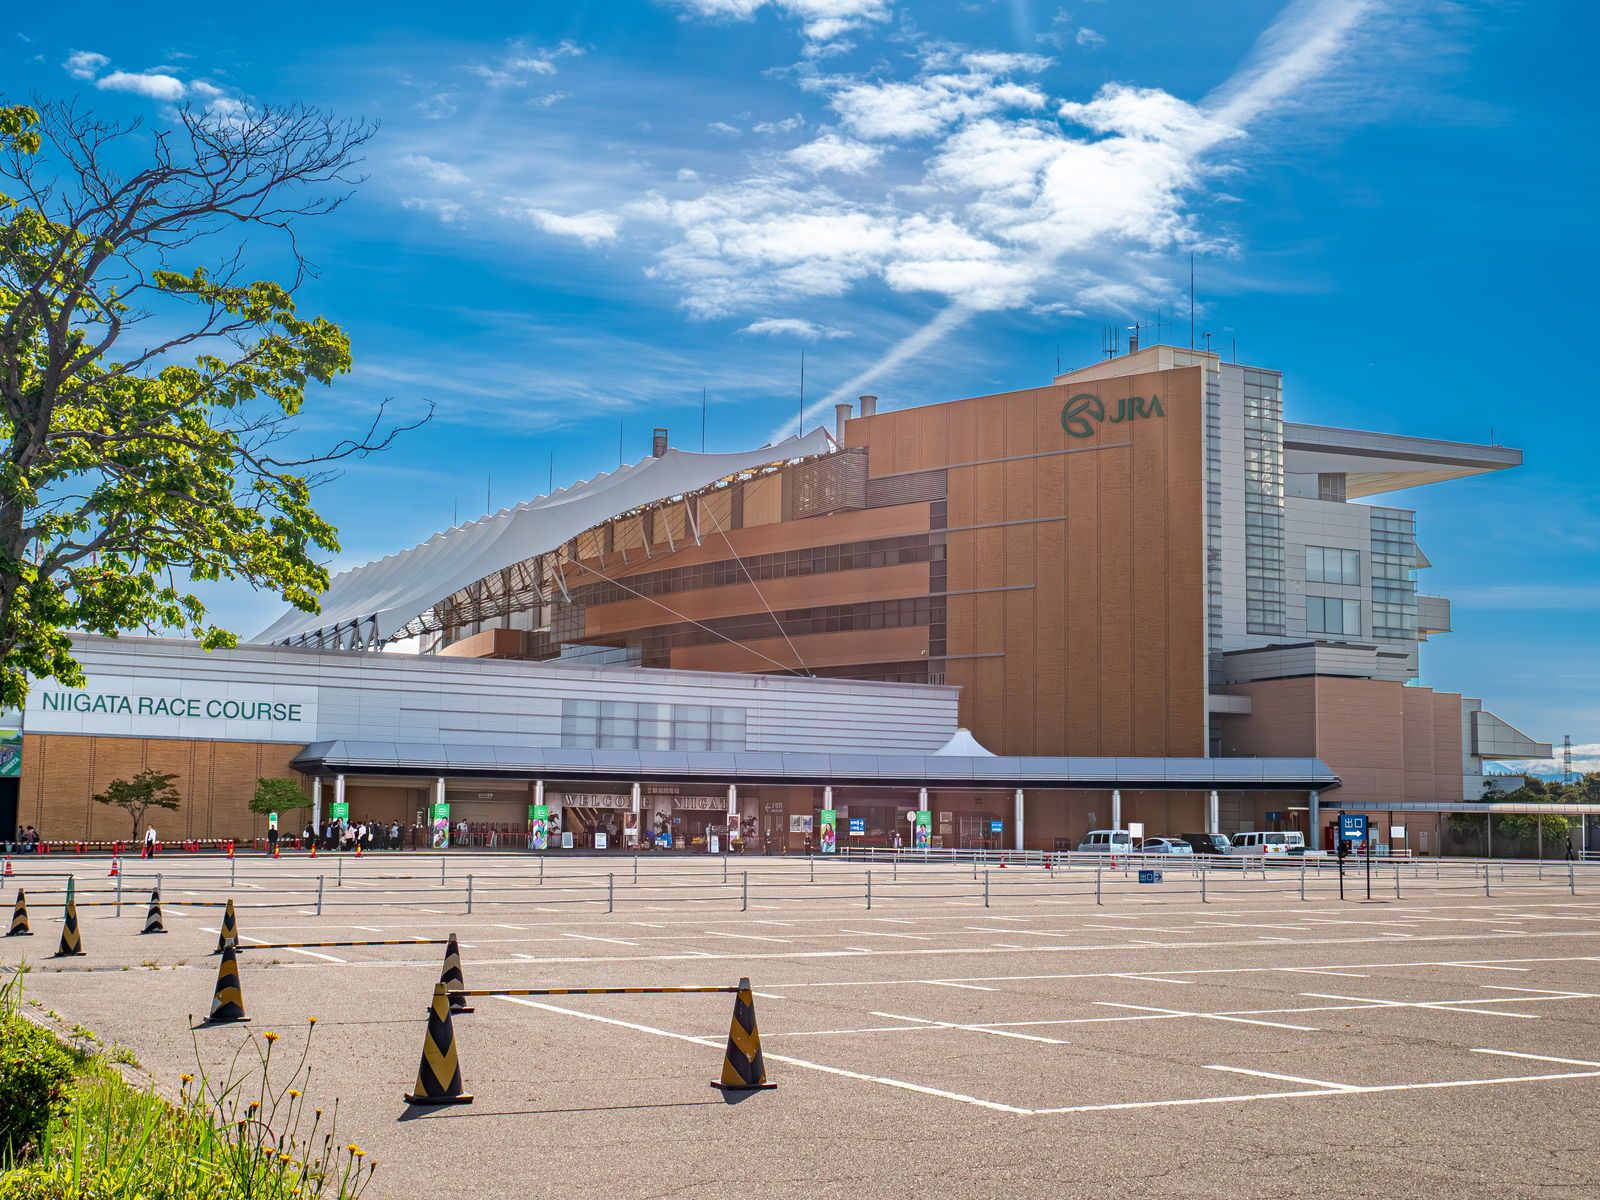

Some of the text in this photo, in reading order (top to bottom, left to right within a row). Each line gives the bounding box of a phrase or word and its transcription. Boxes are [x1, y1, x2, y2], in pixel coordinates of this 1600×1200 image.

[1109, 394, 1165, 423] JRA
[42, 692, 301, 721] NIIGATA RACE COURSE
[672, 797, 728, 809] NIIGAT
[1344, 817, 1362, 828] 出口
